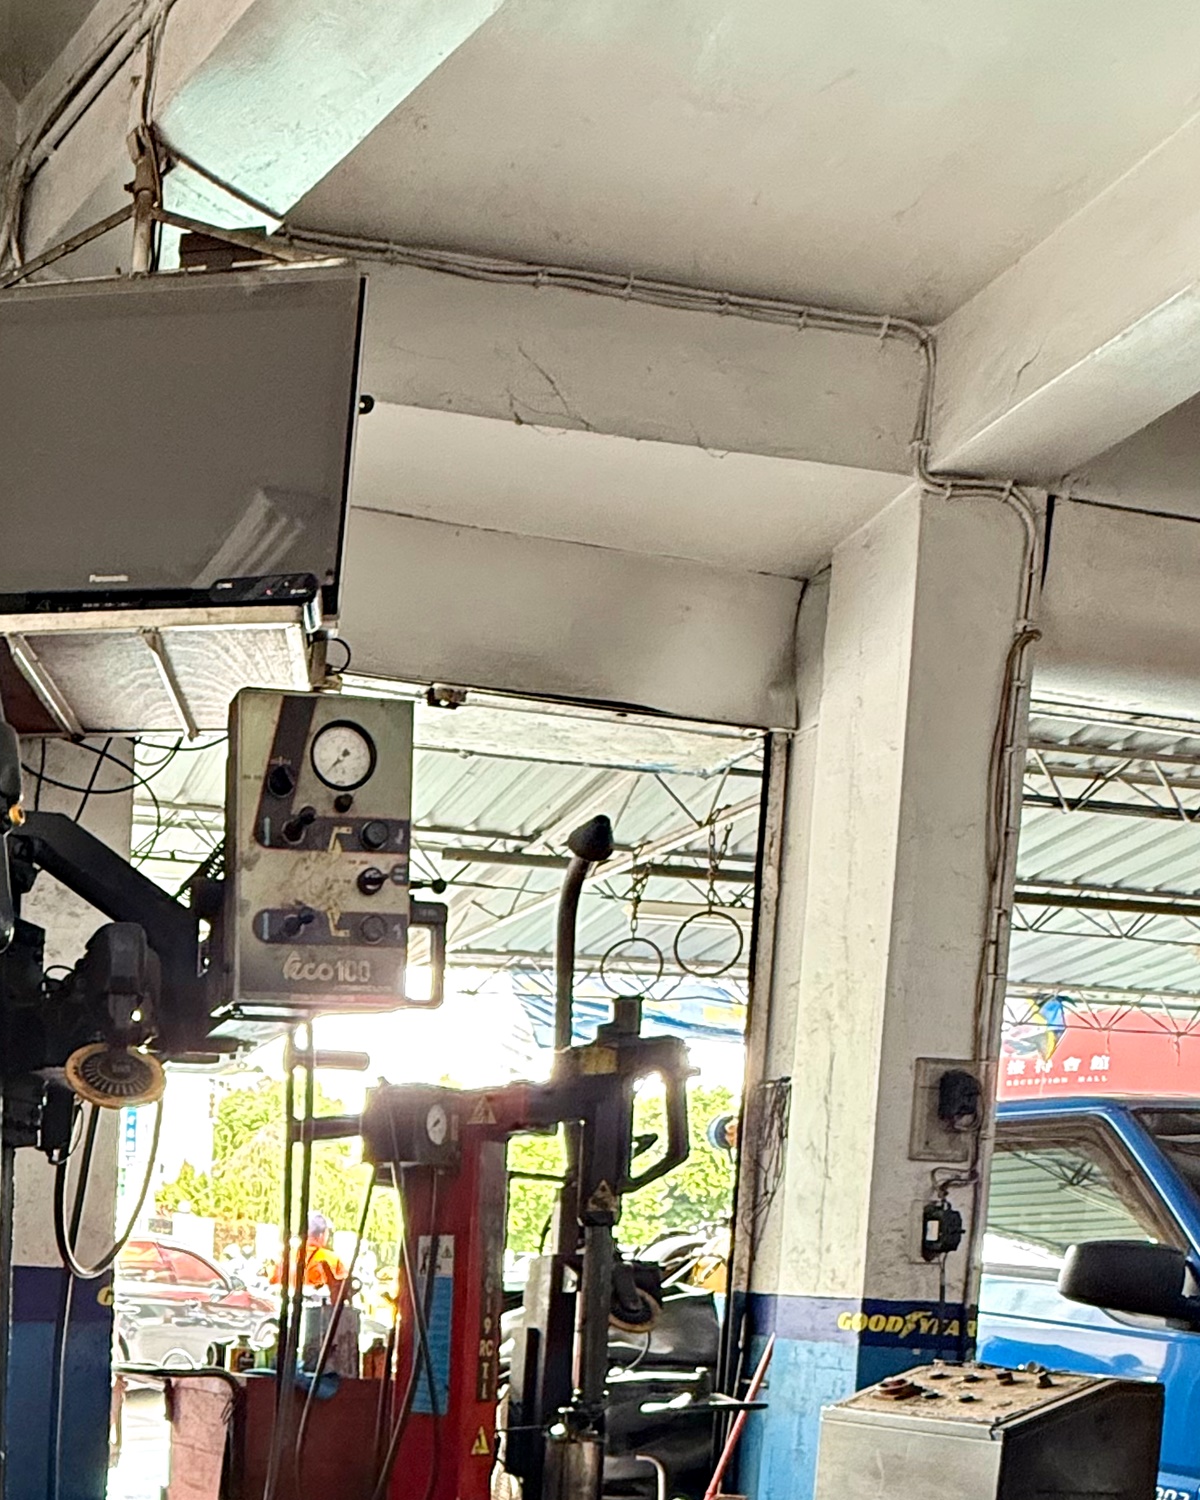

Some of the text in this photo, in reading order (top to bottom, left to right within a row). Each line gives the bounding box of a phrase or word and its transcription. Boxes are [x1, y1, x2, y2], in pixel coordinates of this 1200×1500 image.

[1007, 1055, 1110, 1075] 接待會館
[1006, 1076, 1068, 1087] RECEPTION
